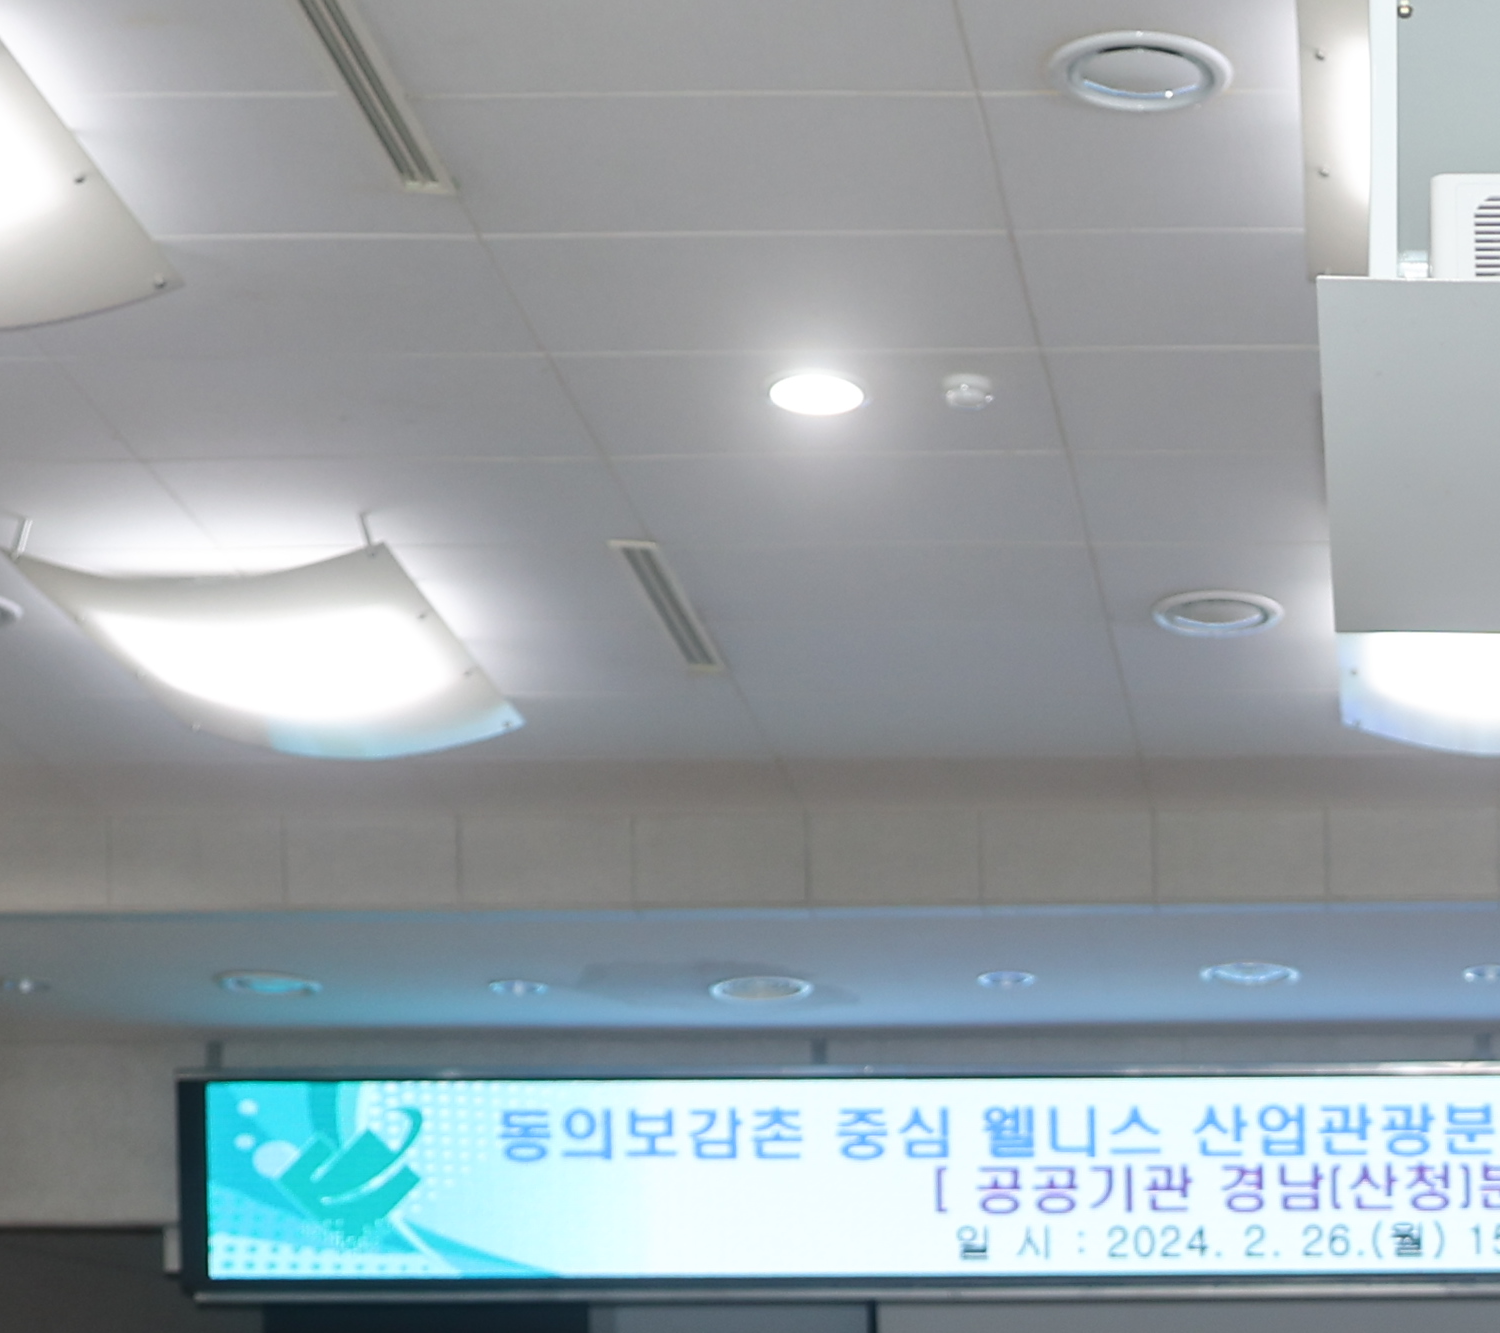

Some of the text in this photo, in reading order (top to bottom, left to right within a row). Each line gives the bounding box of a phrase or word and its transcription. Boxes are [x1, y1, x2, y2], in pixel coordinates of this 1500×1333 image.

[498, 1107, 804, 1163] 동의보감촌
[837, 1106, 950, 1161] 중심
[982, 1104, 1162, 1158] 웰니스
[976, 1164, 1192, 1214] 공공기관
[1106, 1225, 1222, 1258] 2024.
